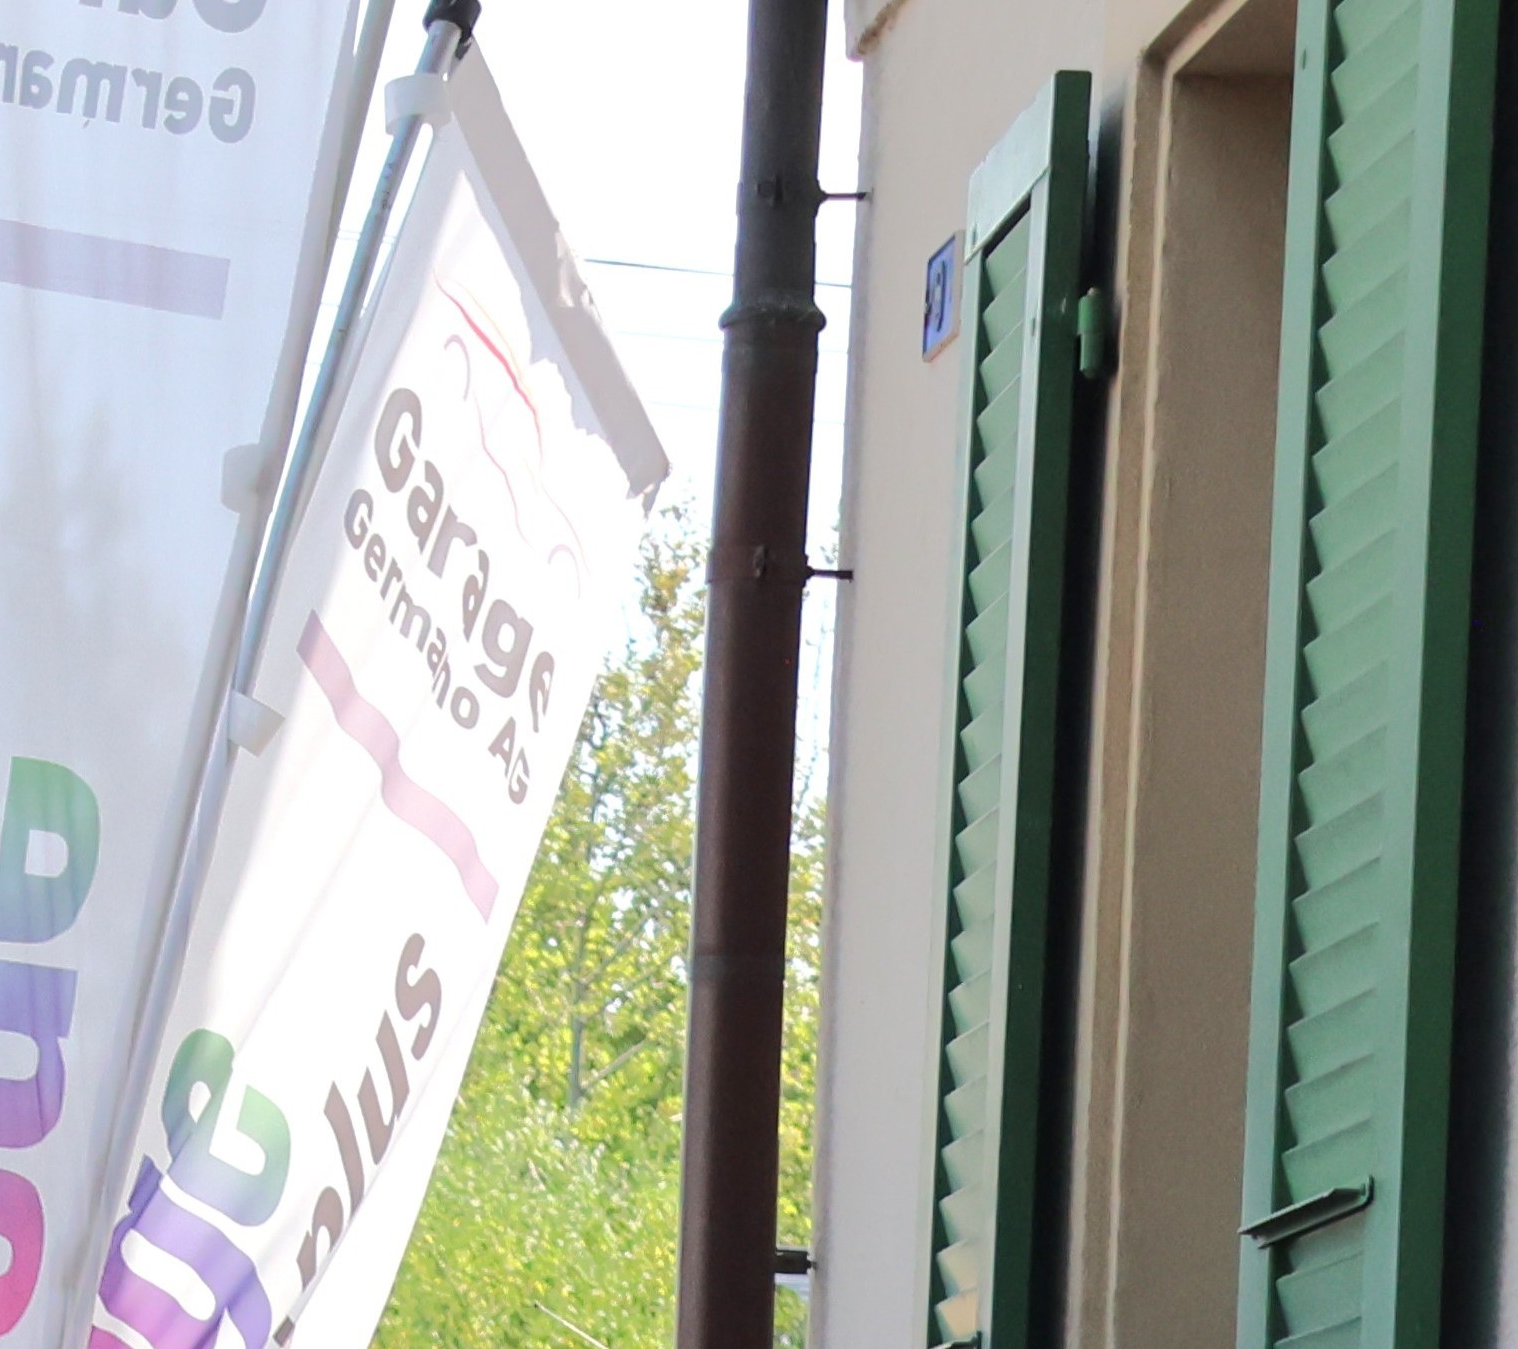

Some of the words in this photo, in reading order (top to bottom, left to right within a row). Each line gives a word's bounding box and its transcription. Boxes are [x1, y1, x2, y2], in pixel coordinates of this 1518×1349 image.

[344, 489, 480, 730] Germano
[488, 716, 530, 805] AG
[374, 388, 555, 733] Garage
